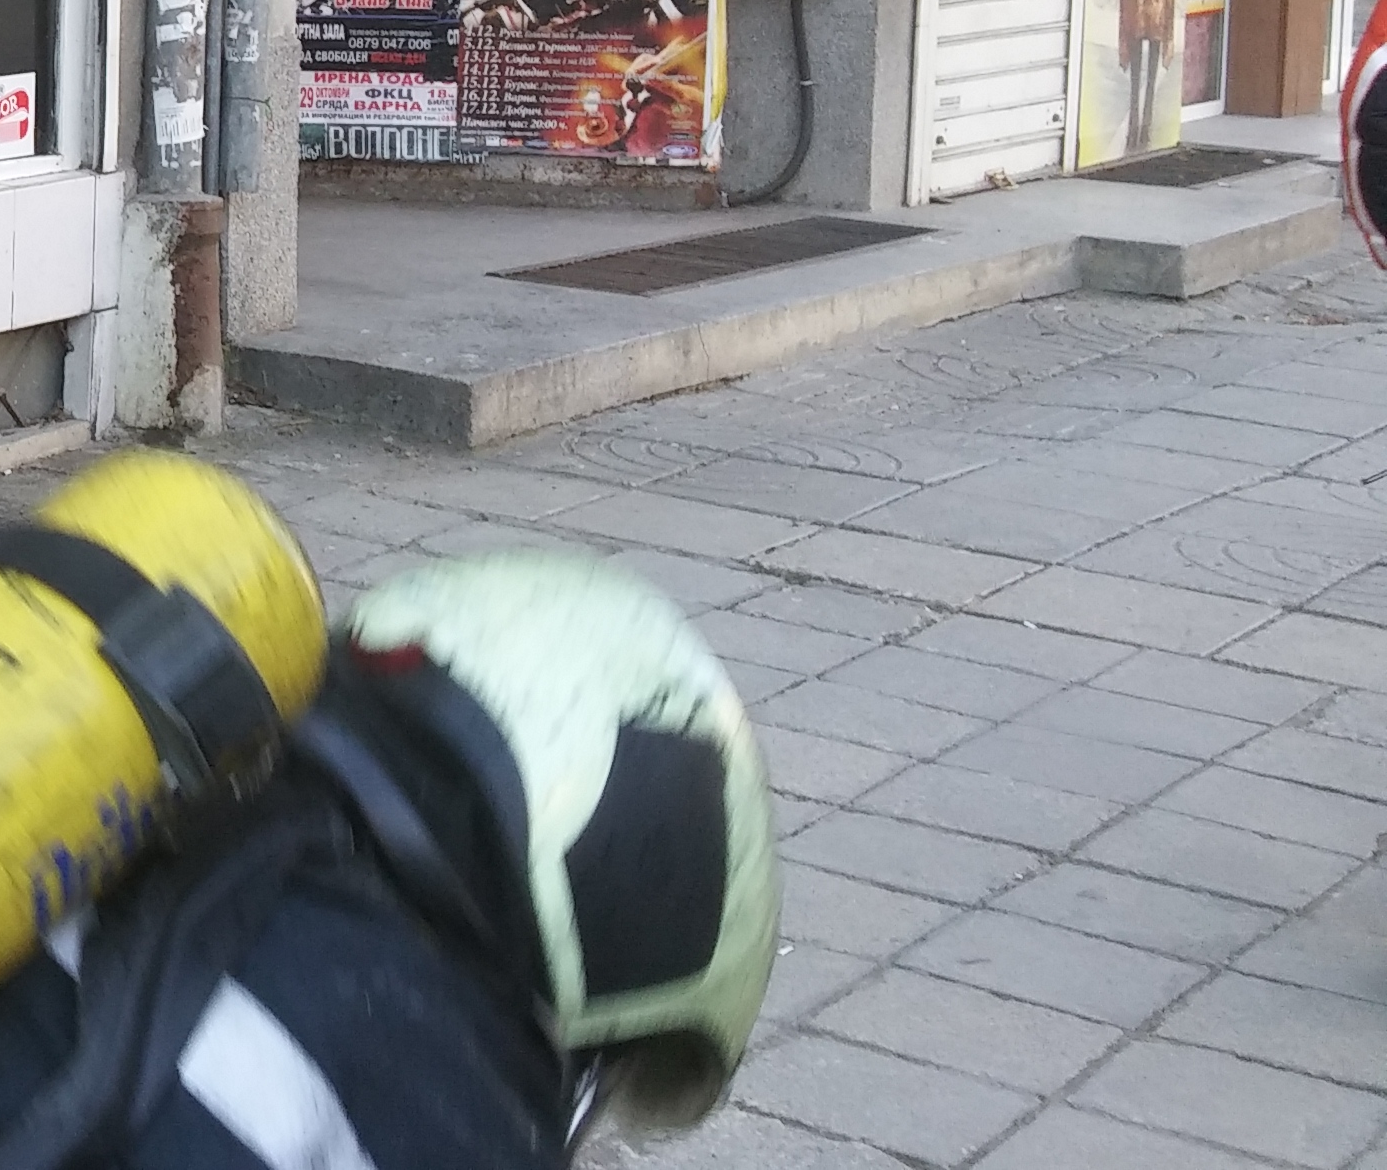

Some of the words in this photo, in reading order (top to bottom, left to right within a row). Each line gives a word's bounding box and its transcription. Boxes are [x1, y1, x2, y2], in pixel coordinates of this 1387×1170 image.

[322, 23, 346, 41] ЗАЛА
[348, 37, 379, 49] 0879
[382, 38, 406, 49] 047
[408, 38, 431, 50] 006
[463, 38, 495, 50] 5.12.
[499, 40, 535, 51] Велико
[315, 50, 368, 65] СВОБОДЕН
[463, 51, 501, 63] 13.12.
[462, 64, 501, 76] 14.12.
[314, 72, 372, 84] ИРЕНА
[462, 77, 501, 89] 15.12.
[300, 87, 314, 108] 29
[365, 88, 413, 101] ФКЦ
[461, 89, 500, 102] 16.12.
[315, 100, 349, 111] СРЯДА
[354, 100, 422, 111] ВАРНА
[461, 102, 499, 114] 17.12.
[312, 112, 364, 120] ИНФОРМАЦИЯ
[461, 116, 506, 127] Начален
[530, 118, 557, 129] 20:00
[329, 126, 450, 161] ВОЛПОНЕ
